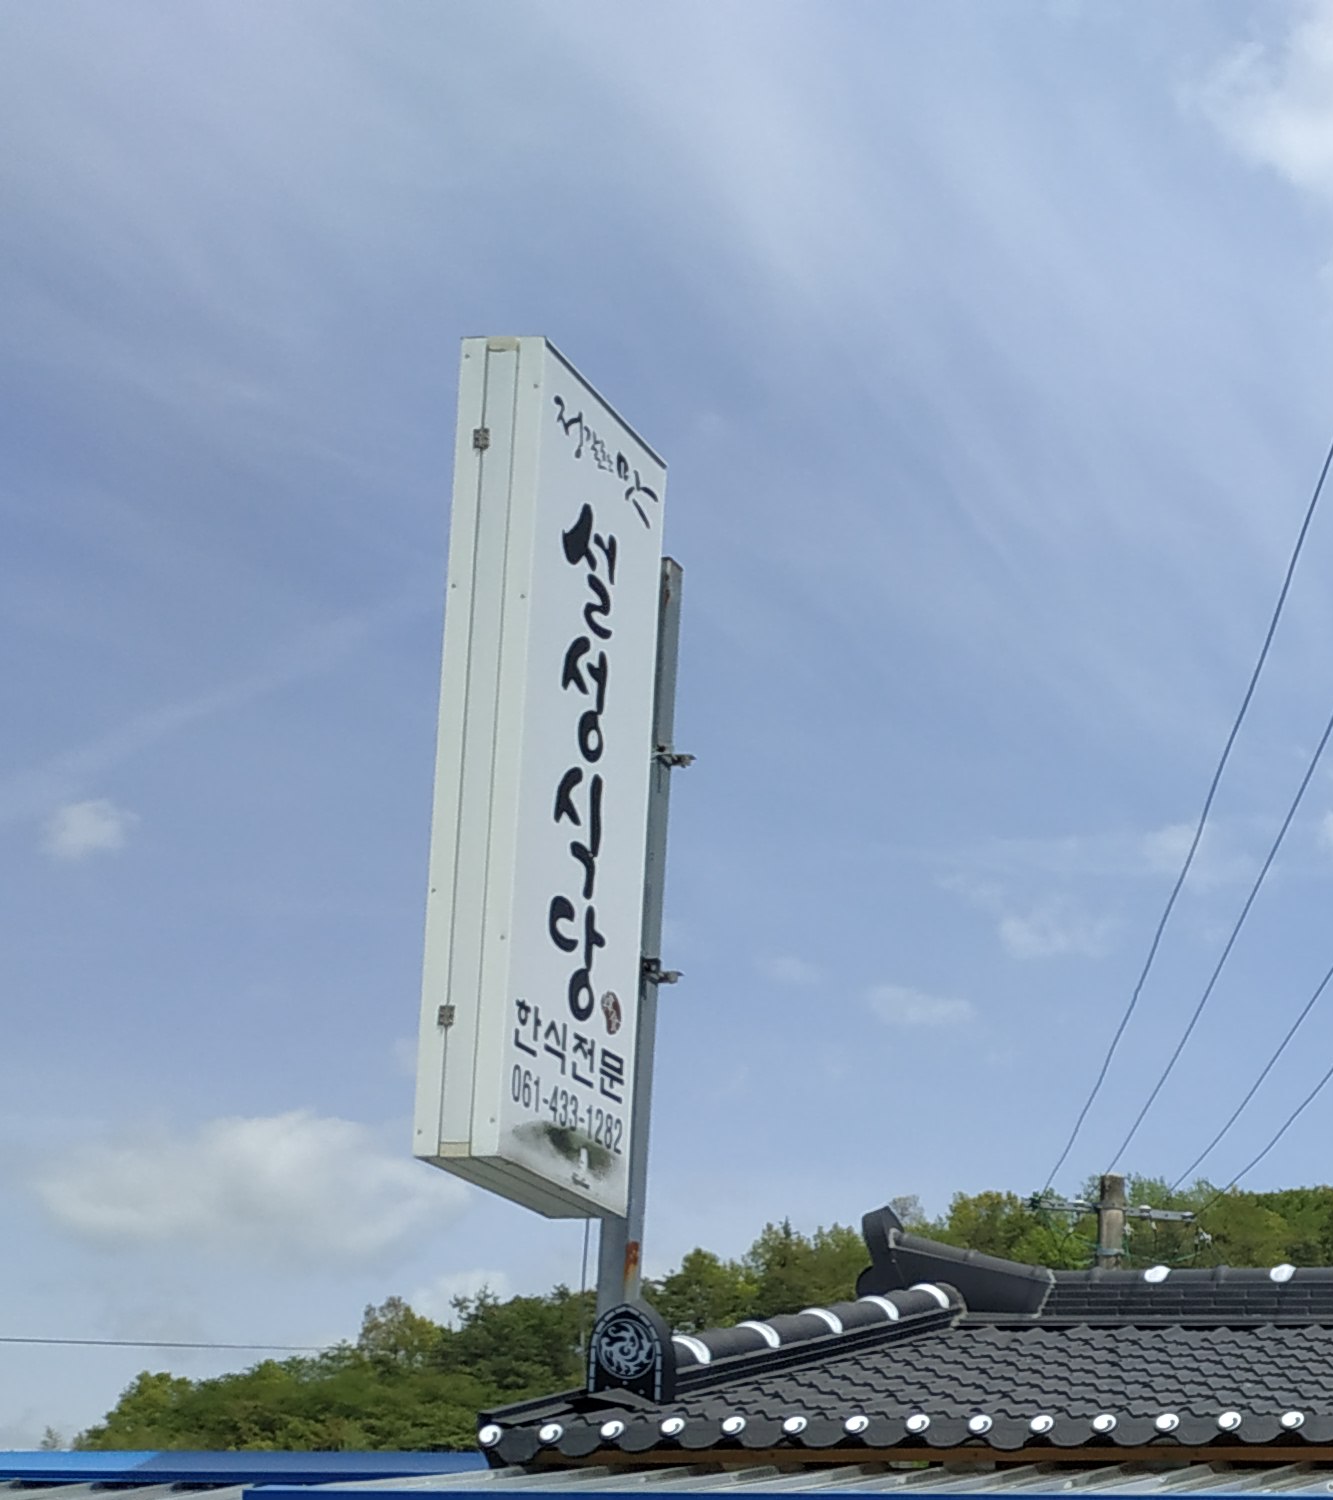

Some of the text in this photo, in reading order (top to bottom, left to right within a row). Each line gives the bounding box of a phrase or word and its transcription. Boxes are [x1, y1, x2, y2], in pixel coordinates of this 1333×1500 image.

[616, 450, 659, 530] 맛
[549, 503, 616, 1022] 설성식당
[513, 998, 626, 1105] 한식전문
[512, 1064, 622, 1155] 061-433-1282
